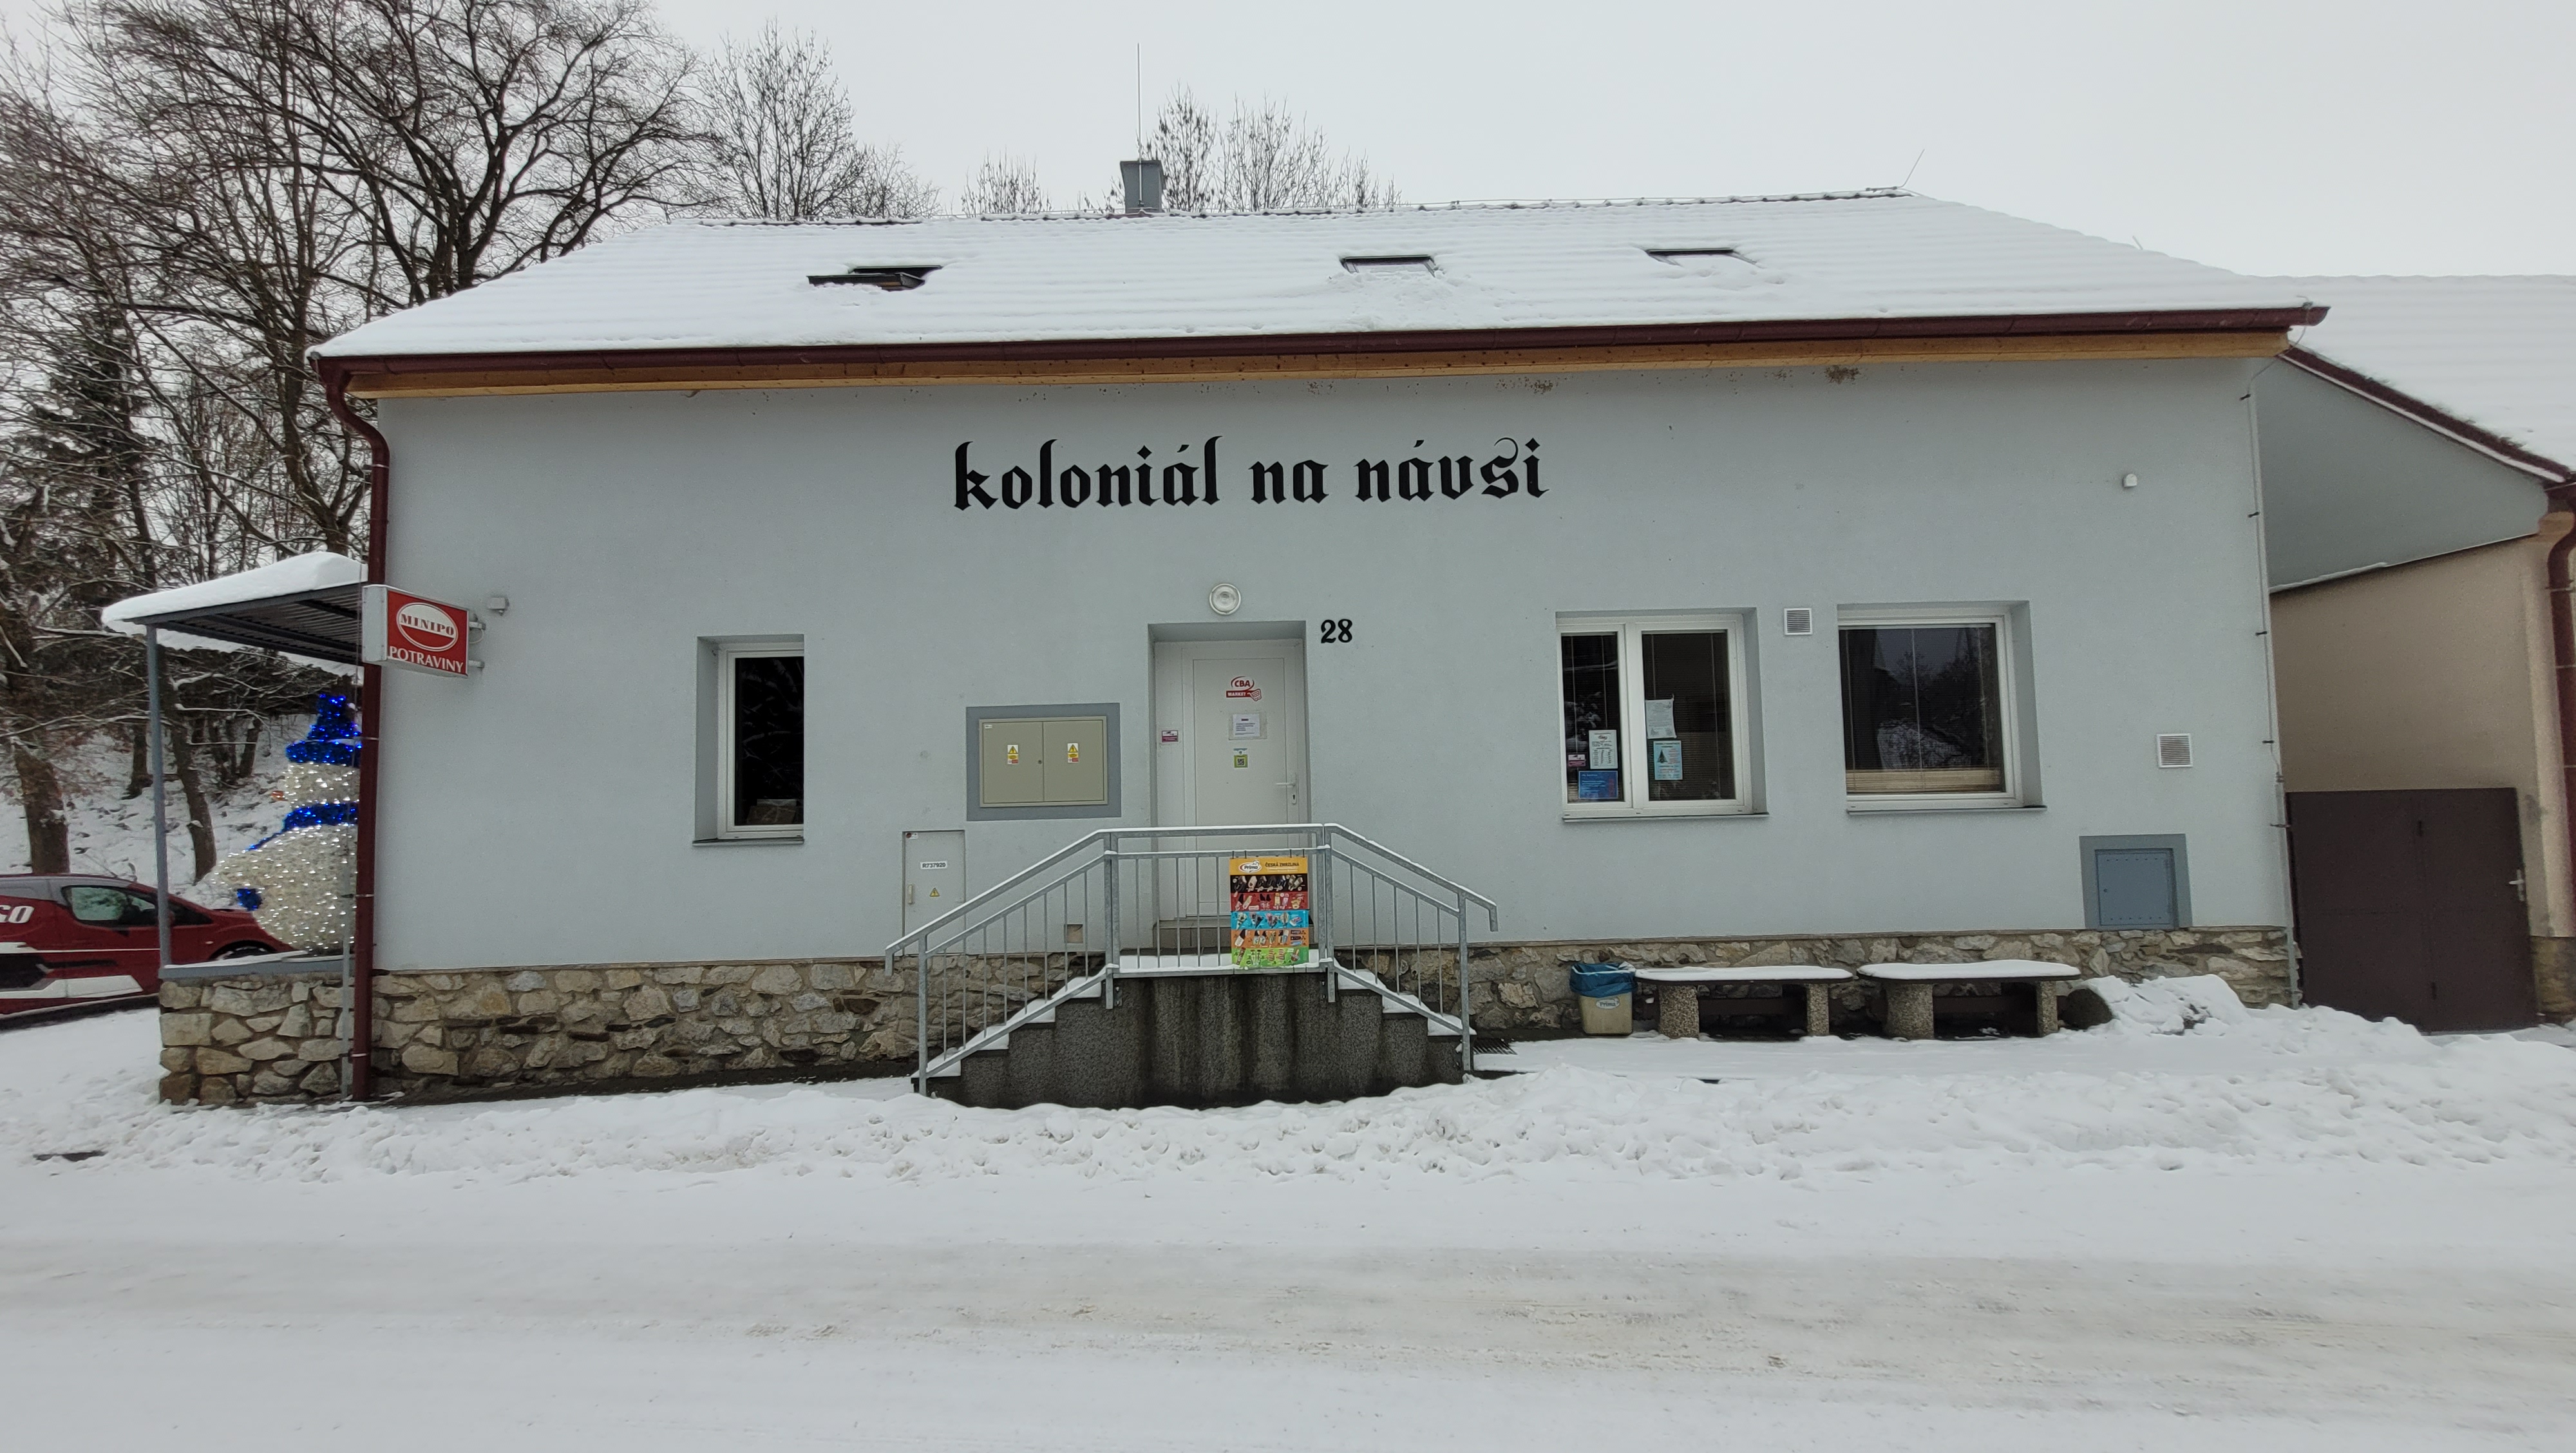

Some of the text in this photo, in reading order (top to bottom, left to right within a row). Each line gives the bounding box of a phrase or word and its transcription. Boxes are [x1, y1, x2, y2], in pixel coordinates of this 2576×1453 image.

[954, 436, 1549, 511] koloniál na návsi
[400, 613, 455, 636] MINIPO
[1320, 618, 1352, 643] 28
[390, 645, 464, 673] POTRAVINY
